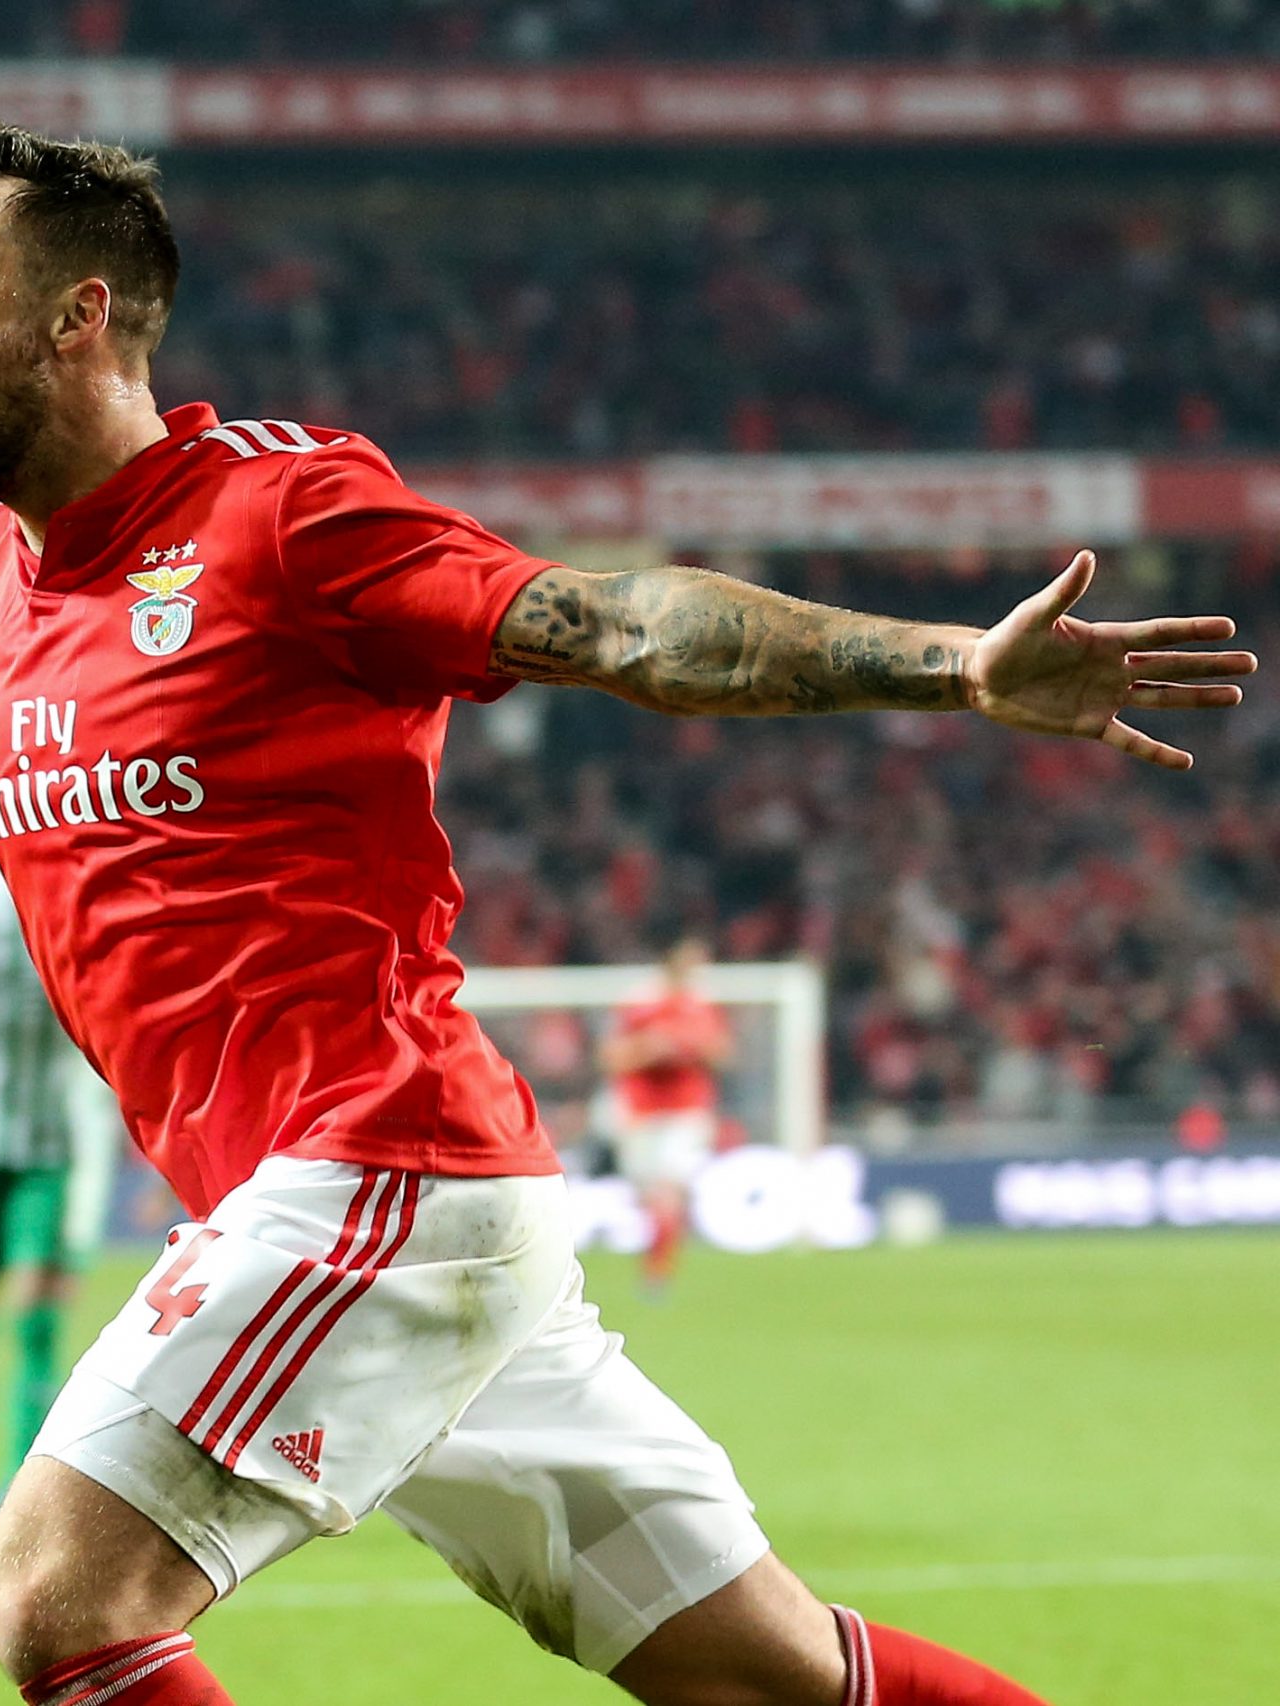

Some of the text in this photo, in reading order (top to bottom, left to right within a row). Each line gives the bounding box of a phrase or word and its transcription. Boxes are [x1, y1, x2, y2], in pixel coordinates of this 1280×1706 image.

[11, 696, 76, 754] Fly
[145, 1228, 223, 1336] 4
[272, 1436, 320, 1484] adidas
